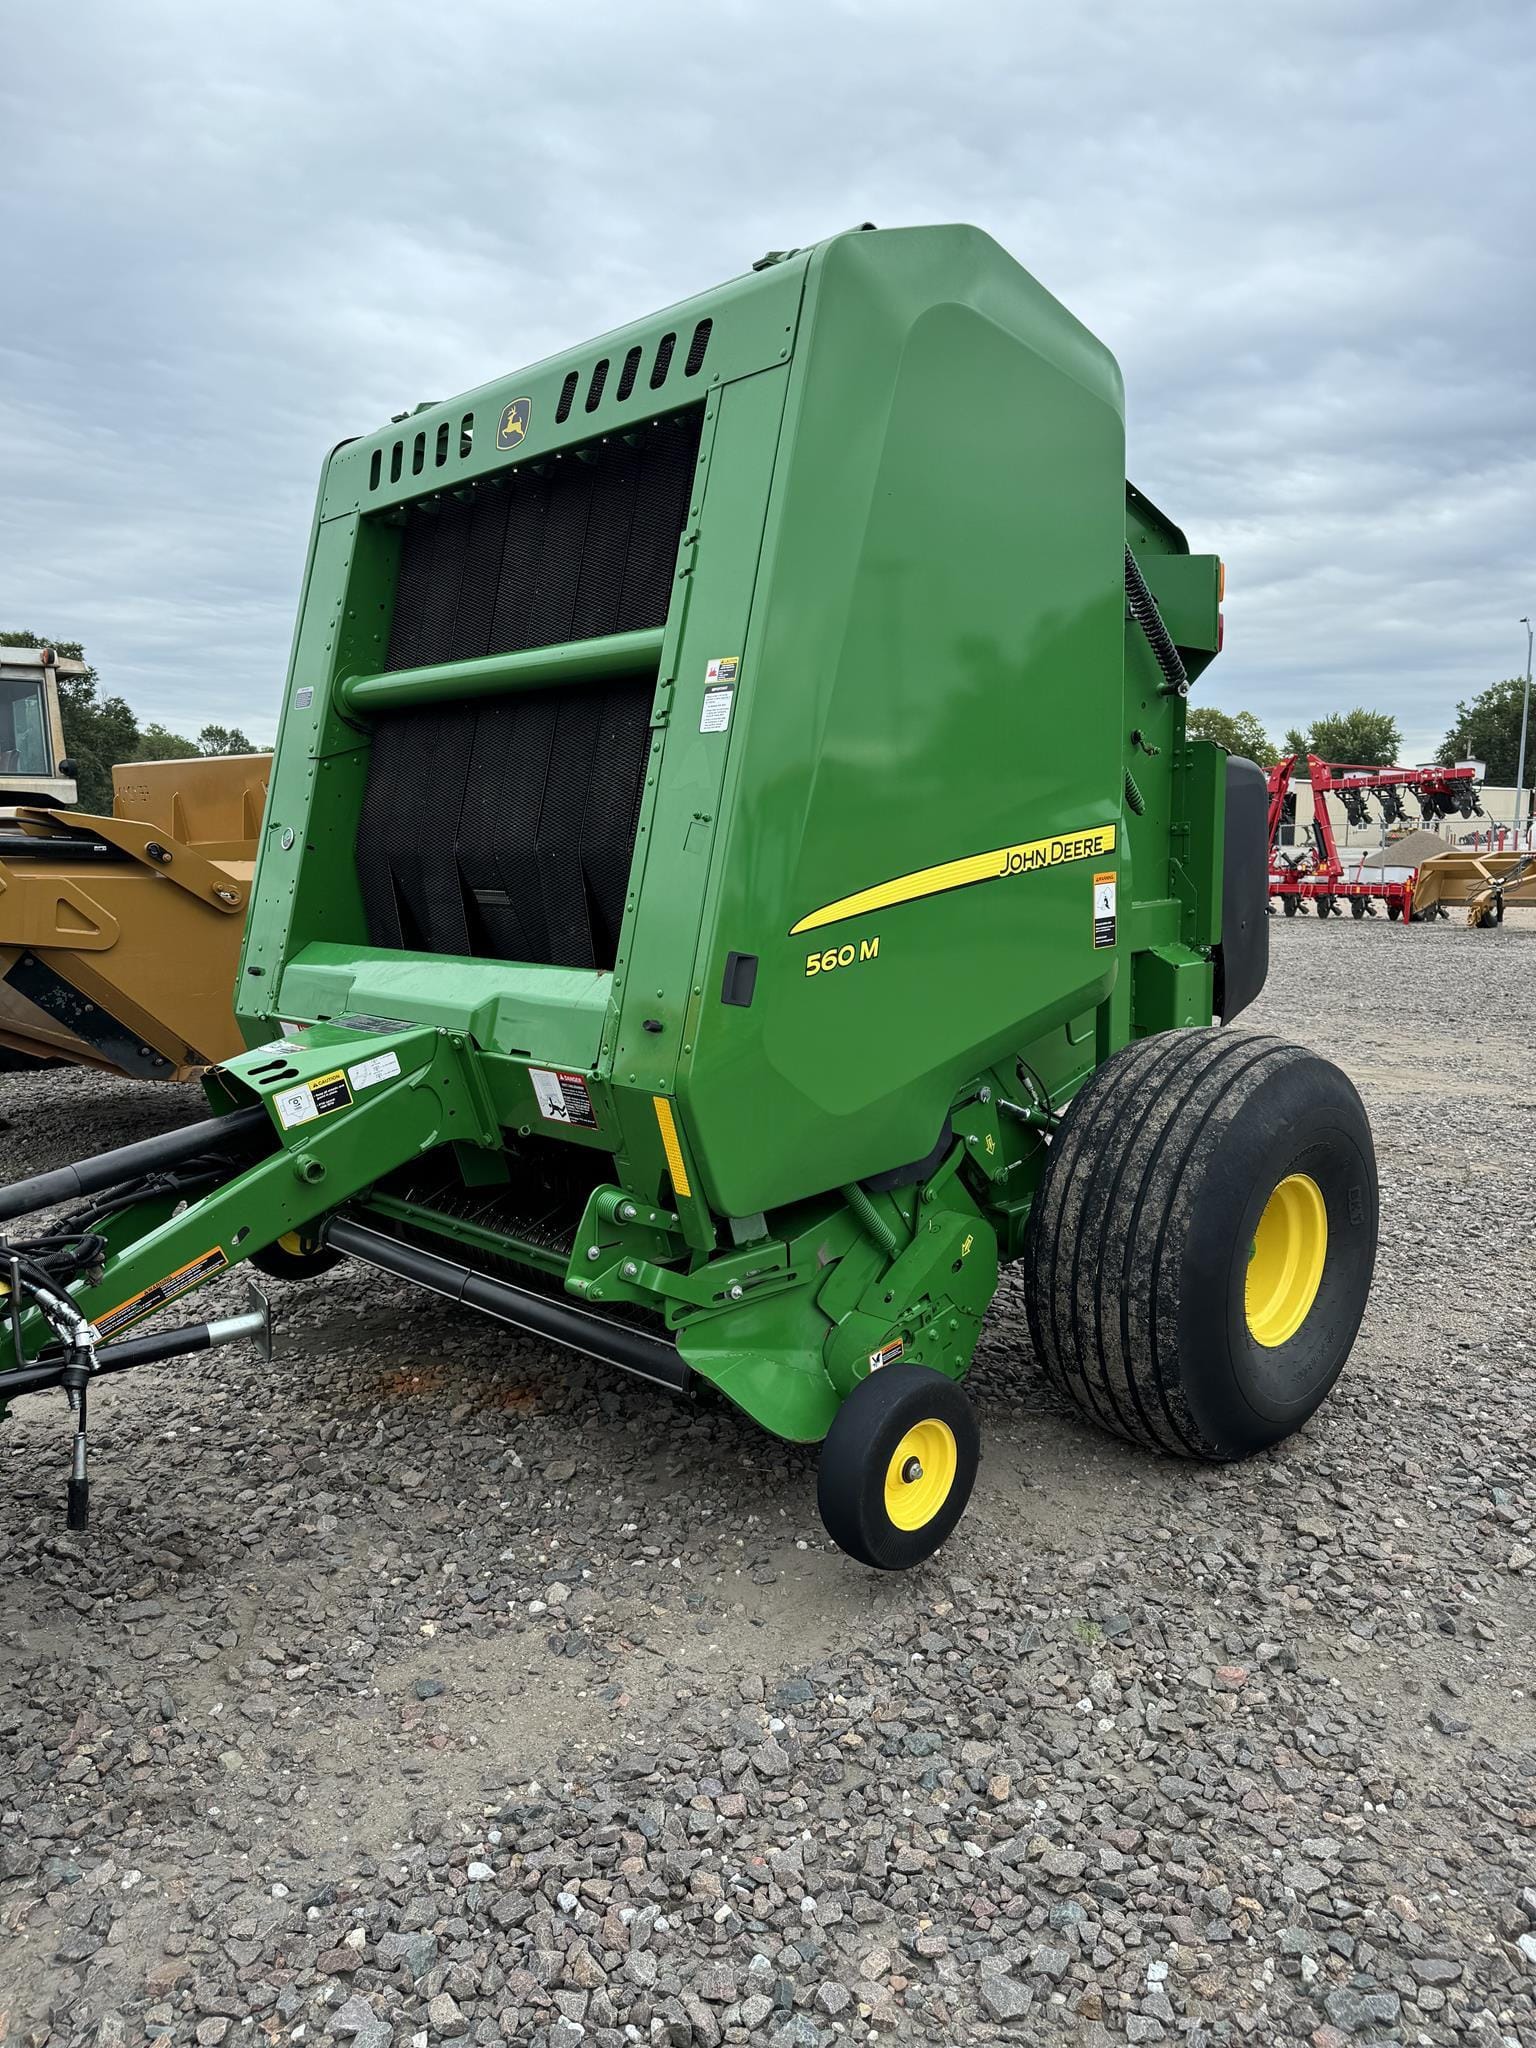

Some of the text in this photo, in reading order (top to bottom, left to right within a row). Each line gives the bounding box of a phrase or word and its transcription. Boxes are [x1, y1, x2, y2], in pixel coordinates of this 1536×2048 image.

[1000, 836, 1104, 875] JOHN DEERE
[805, 935, 880, 977] 560 M
[318, 1074, 341, 1086] CAUTION
[149, 1276, 174, 1291] WARNING
